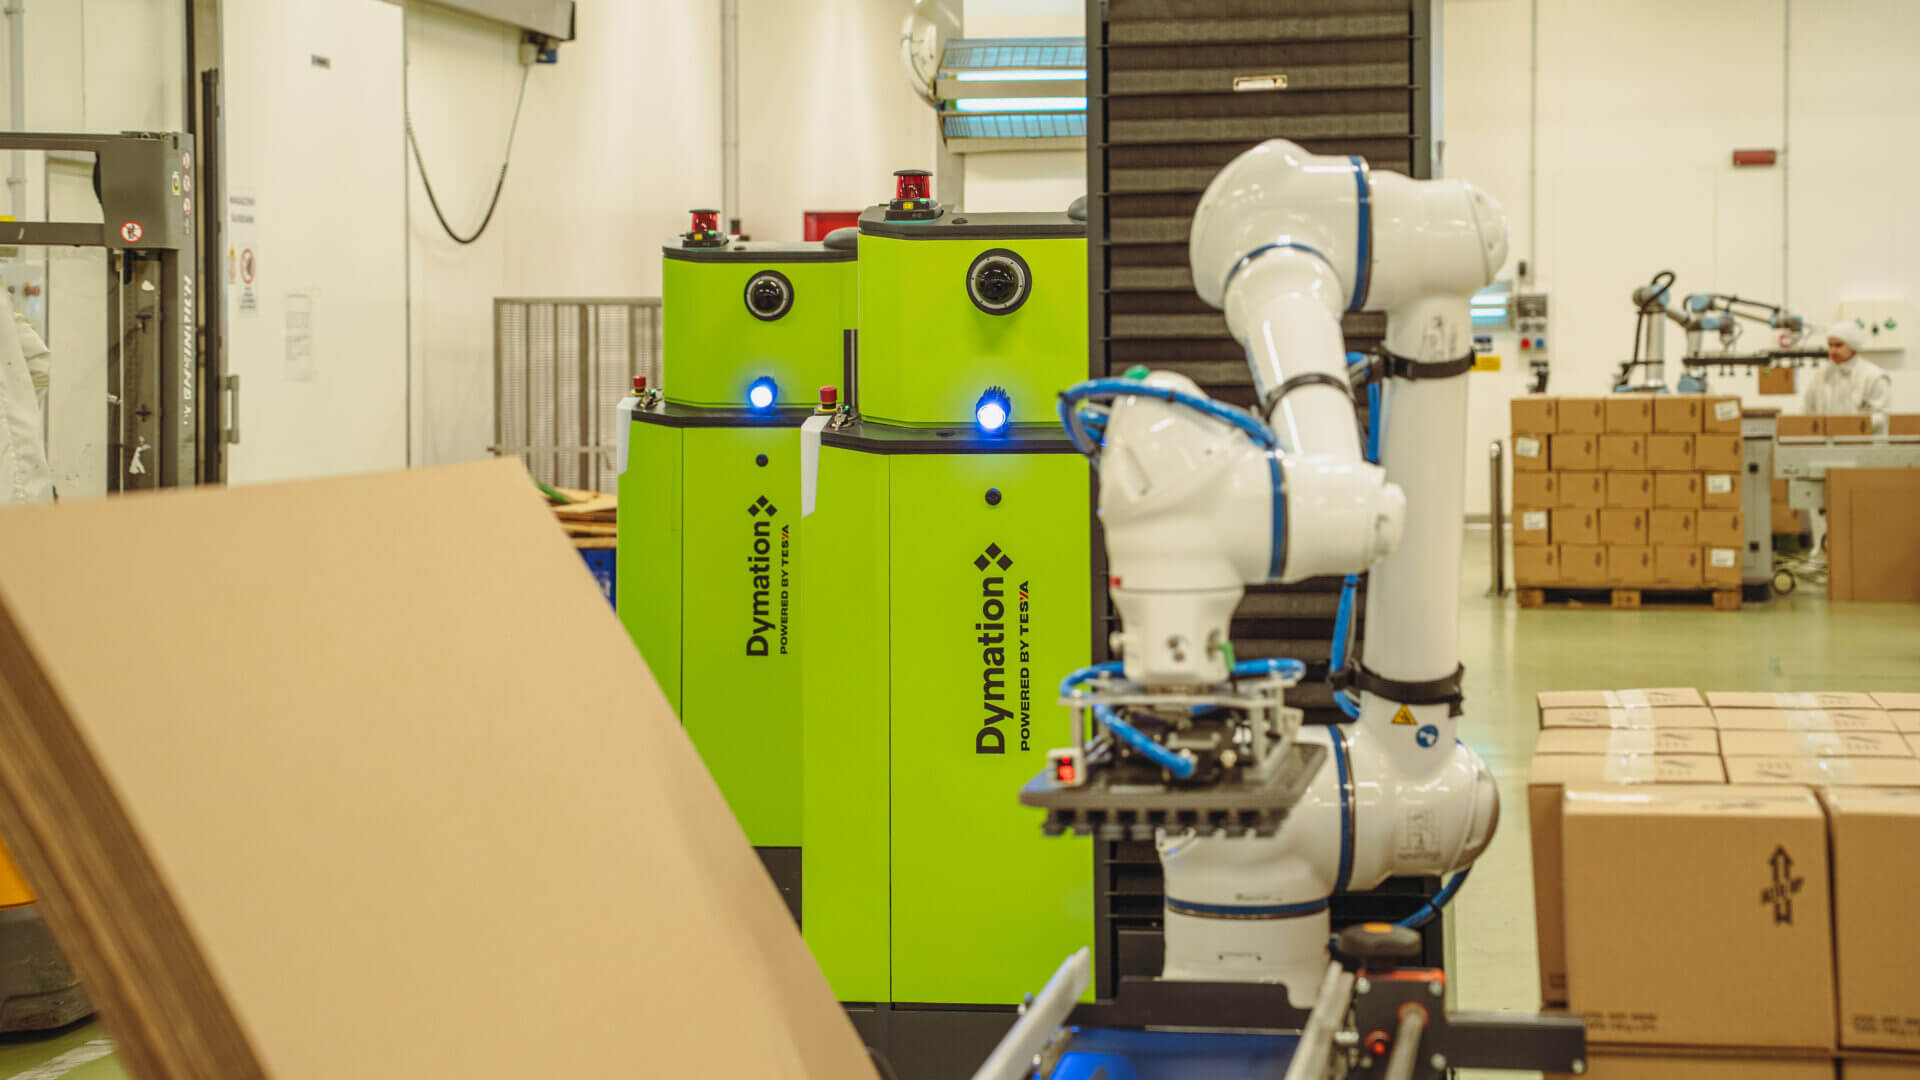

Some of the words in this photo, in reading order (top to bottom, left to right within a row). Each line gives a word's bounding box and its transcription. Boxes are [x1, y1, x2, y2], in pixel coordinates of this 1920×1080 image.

[746, 521, 776, 657] Dymation
[780, 569, 789, 588] BY
[1019, 580, 1029, 637] TESYA
[779, 590, 789, 655] POWERED
[1019, 639, 1030, 663] BY
[975, 576, 1015, 755] Dymation
[1019, 667, 1031, 752] POWERED
